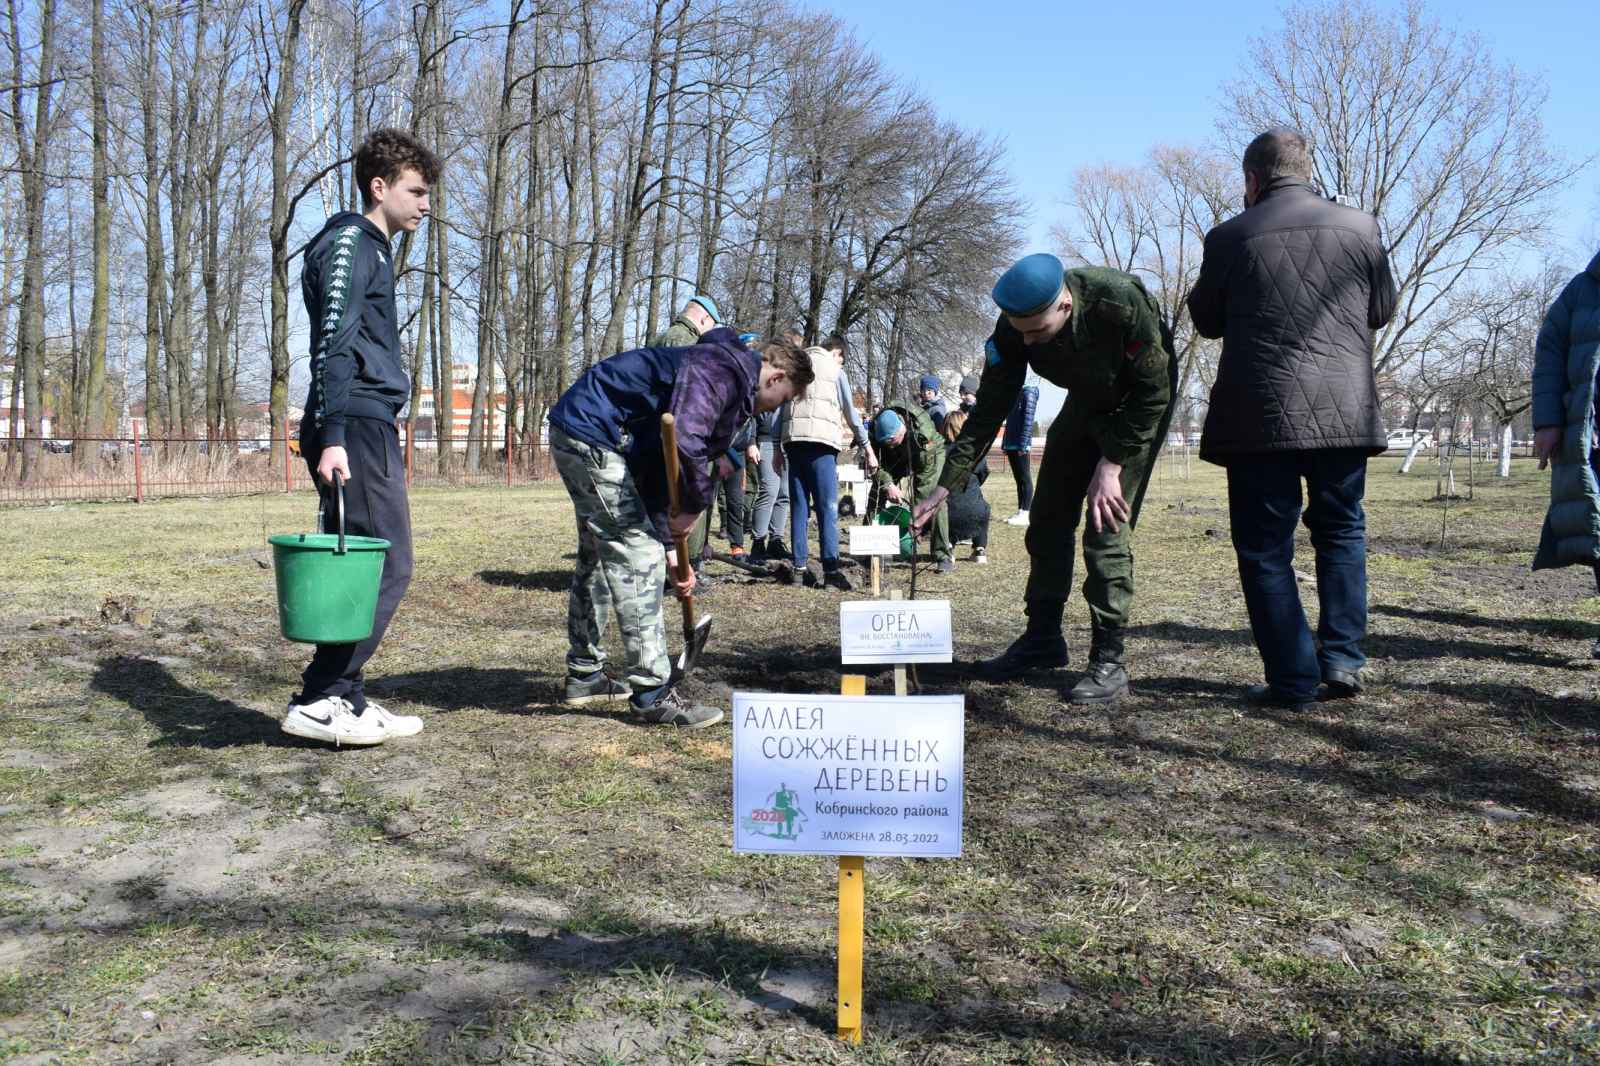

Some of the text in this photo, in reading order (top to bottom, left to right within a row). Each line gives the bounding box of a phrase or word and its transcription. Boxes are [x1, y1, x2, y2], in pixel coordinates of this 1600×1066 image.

[743, 705, 824, 730] АЛЛЕЯ
[761, 735, 940, 763] СОЖЖЁННЫХ
[813, 767, 948, 795] ДЕРЕВЕНЬ
[815, 801, 950, 820] Кобринского района
[820, 831, 939, 845] ЗАЛОЖЕНА 28.03.2022
